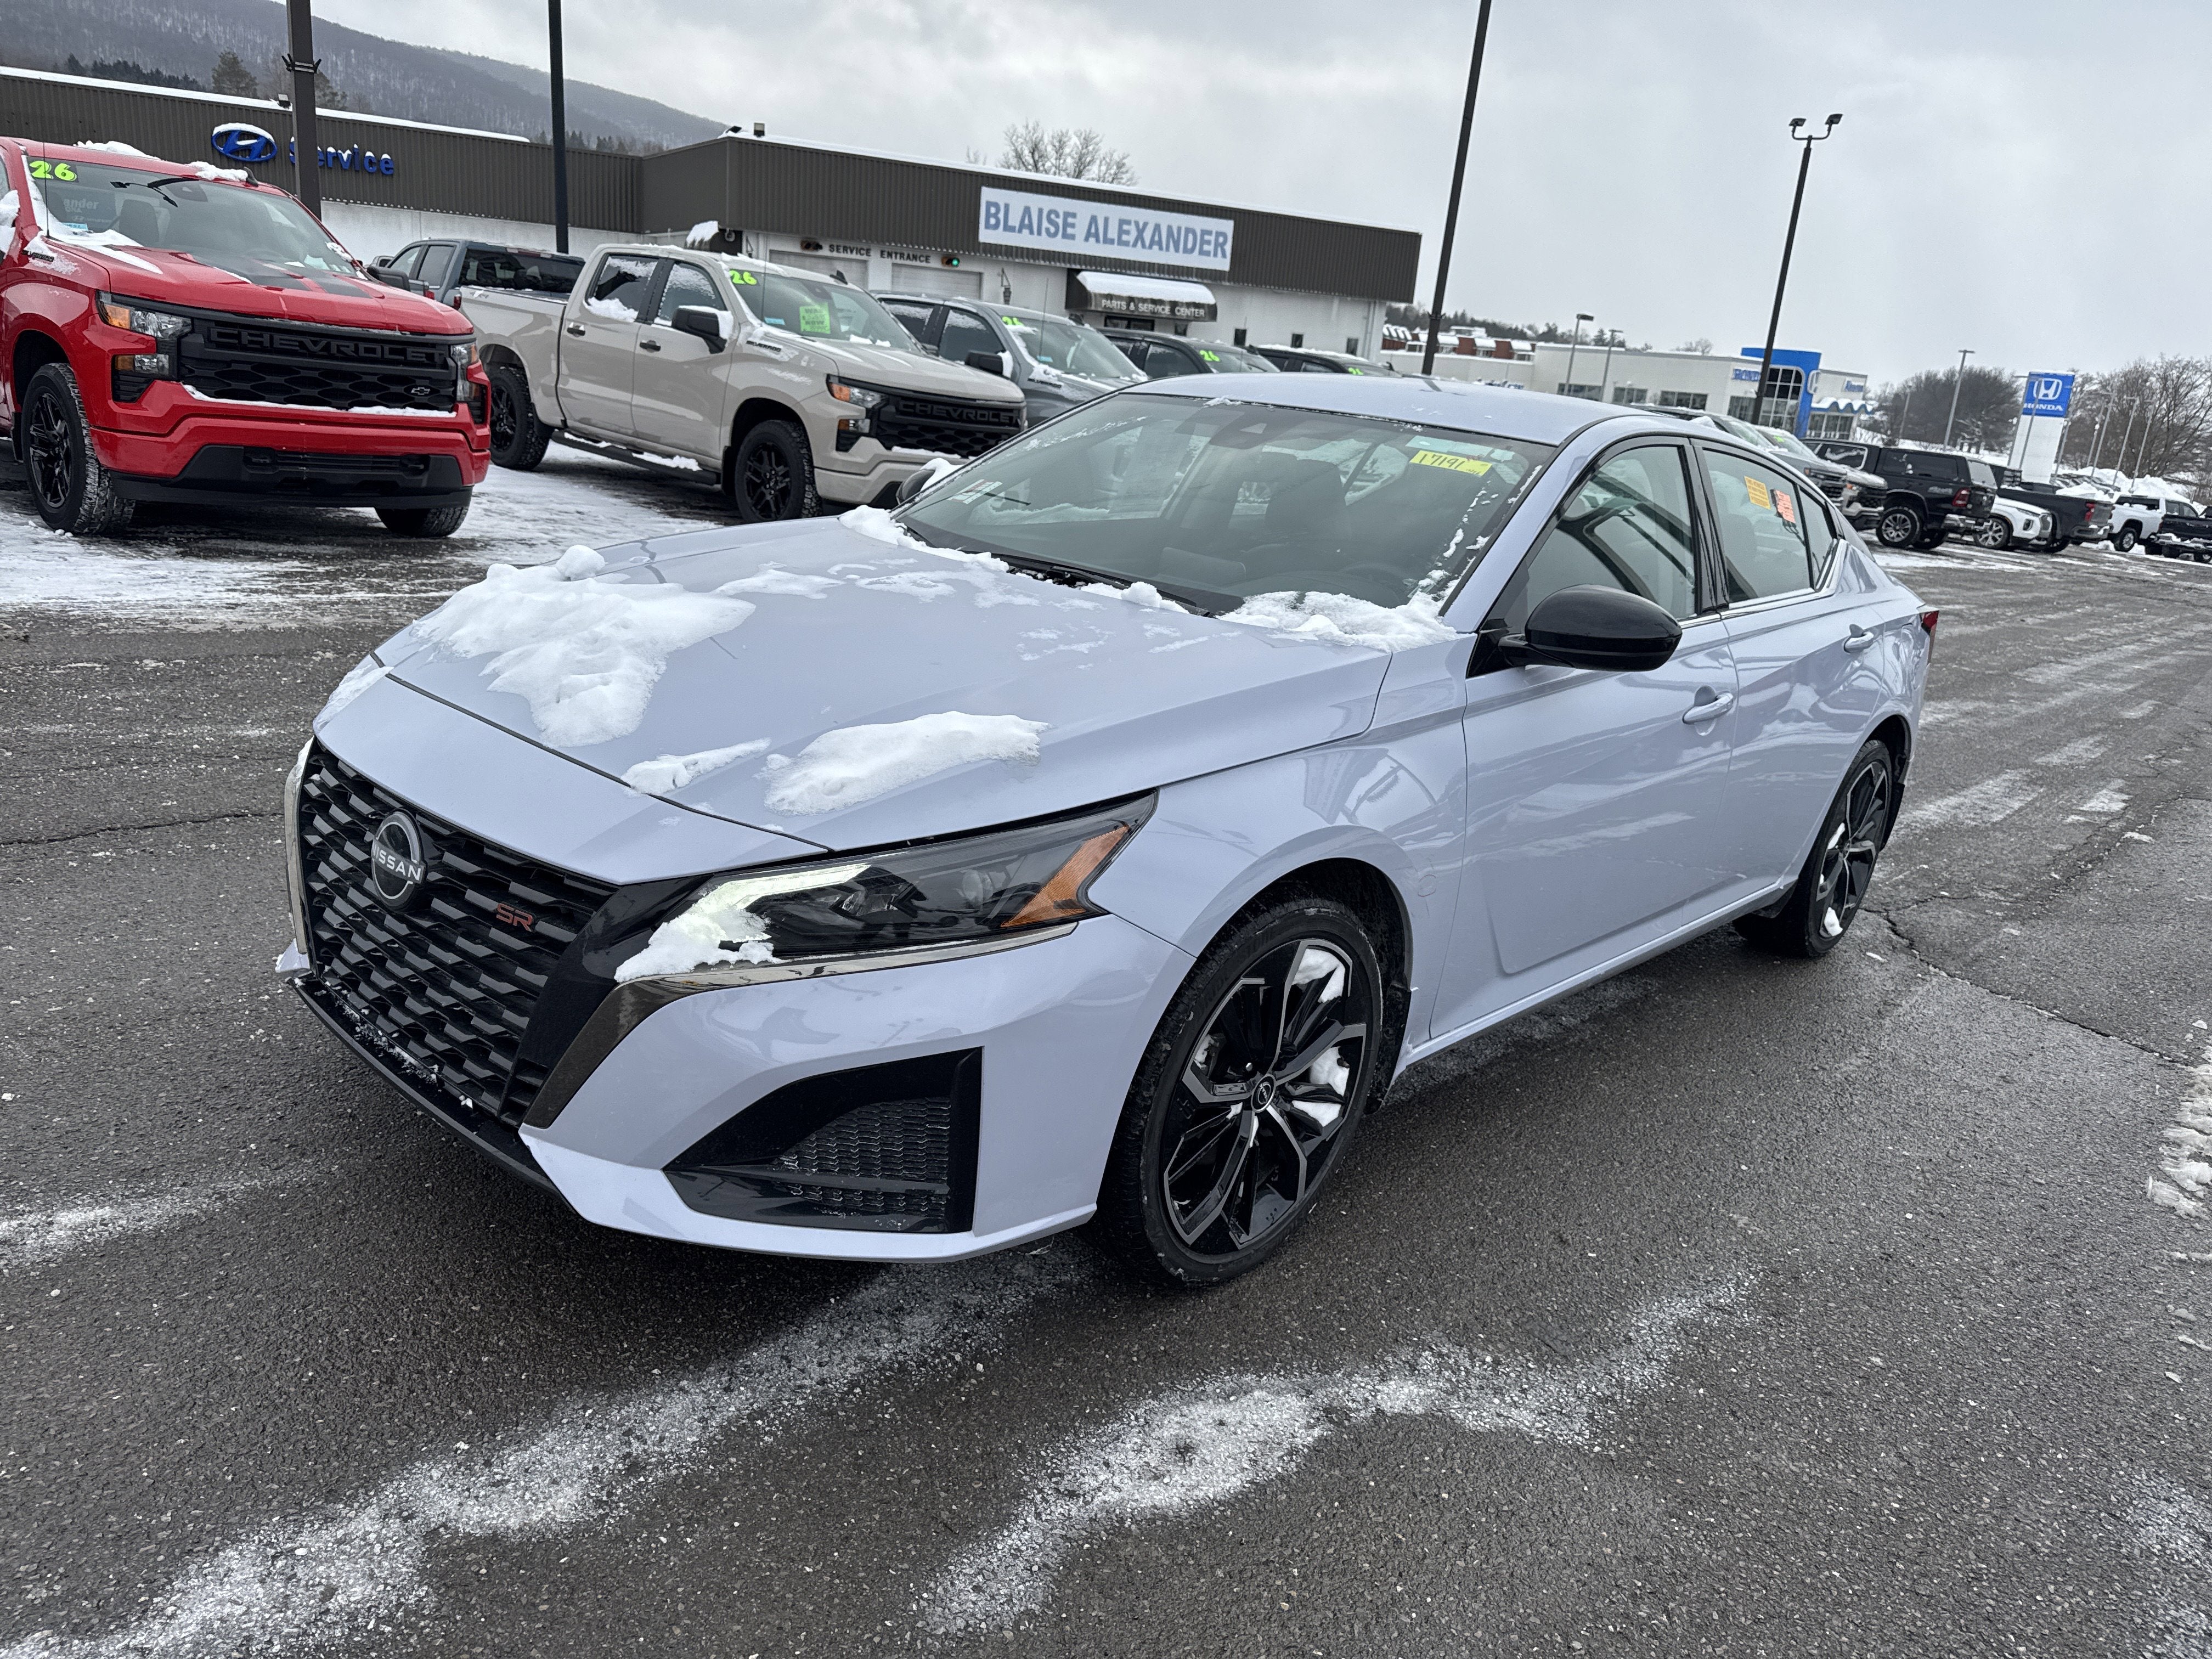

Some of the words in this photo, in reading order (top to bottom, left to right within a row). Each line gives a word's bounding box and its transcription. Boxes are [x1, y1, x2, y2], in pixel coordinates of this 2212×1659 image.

[29, 160, 77, 182] 26
[984, 200, 1077, 240] BLAISE
[1084, 214, 1228, 259] ALEXANDER
[829, 244, 872, 257] SERVICE
[880, 250, 931, 263] ENTRANCE
[729, 270, 757, 285] 26
[1102, 300, 1127, 311] PARTS
[1129, 302, 1135, 311] &
[1138, 303, 1171, 314] SERVICE
[1175, 307, 1205, 317] CENTER
[210, 327, 448, 363] CHEVROLET
[1199, 350, 1220, 362] 26
[899, 400, 1019, 424] CHEVROLET
[2023, 403, 2064, 411] HONDA
[371, 843, 421, 881] NISSAN
[496, 902, 533, 932] SR
